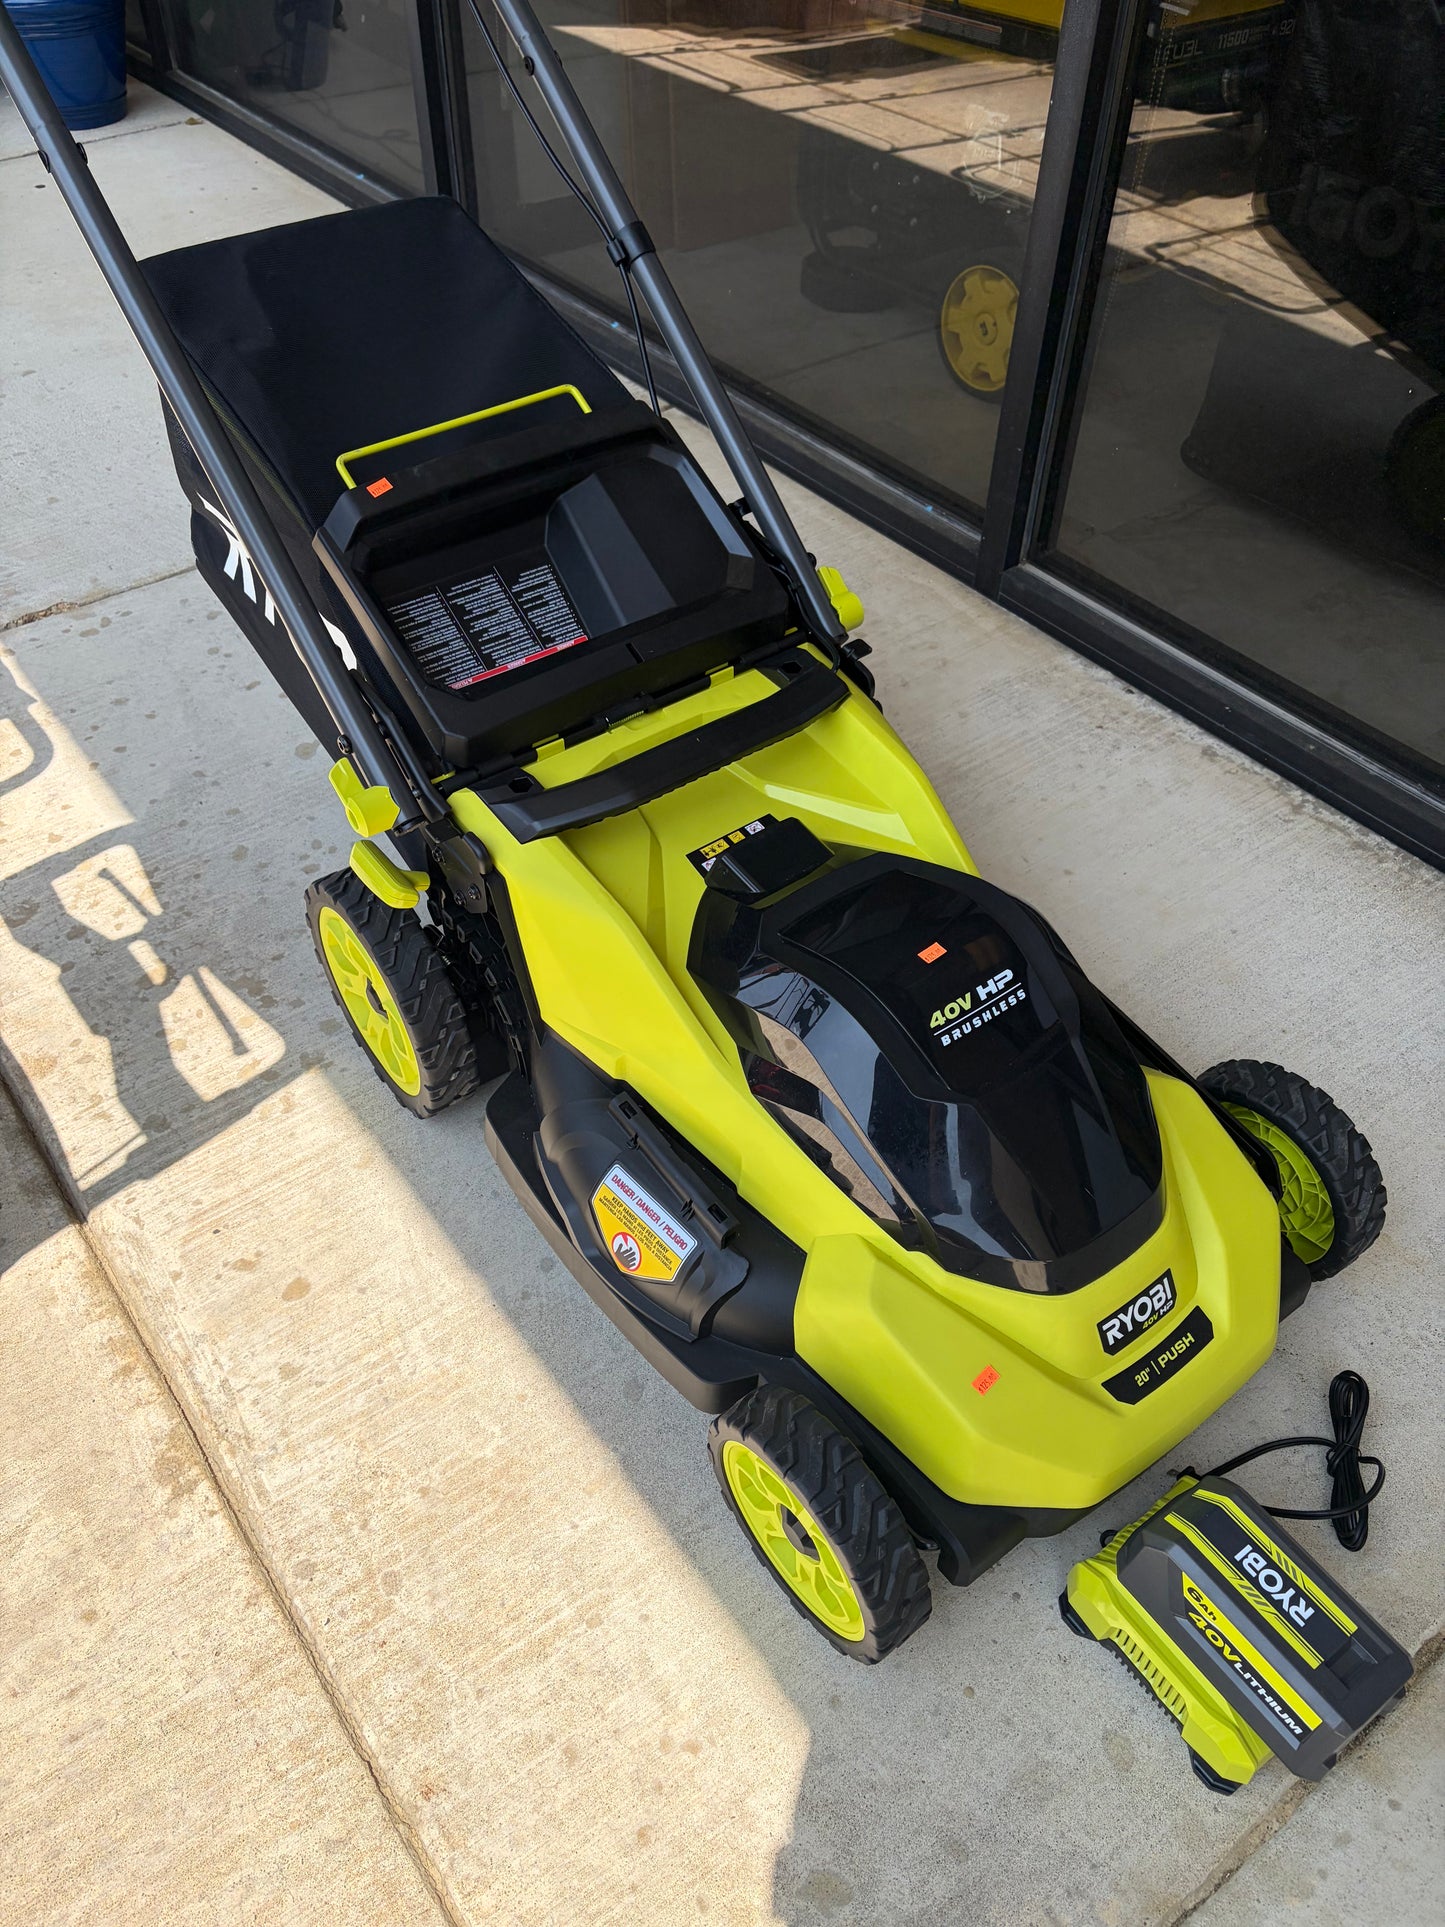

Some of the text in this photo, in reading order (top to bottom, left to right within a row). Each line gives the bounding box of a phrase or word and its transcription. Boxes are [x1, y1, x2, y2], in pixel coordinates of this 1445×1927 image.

[929, 969, 1013, 1028] 40V HP
[940, 989, 1026, 1046] BRUSHLESS
[611, 1174, 636, 1200] DANGER
[636, 1198, 661, 1224] DANGER
[663, 1224, 688, 1251] PELIGRO
[612, 1196, 624, 1209] KEEP
[623, 1206, 638, 1223] HANDS
[645, 1229, 657, 1241] FEET
[655, 1239, 669, 1253] AWAY
[1102, 1277, 1172, 1346] RYOBI
[1142, 1300, 1173, 1329] 40V HP
[1135, 1333, 1195, 1386] 20" PUSH
[1187, 1586, 1217, 1621] 6Ah
[1234, 1545, 1315, 1627] RYOBI
[1188, 1612, 1303, 1735] 40V LITHIUM
